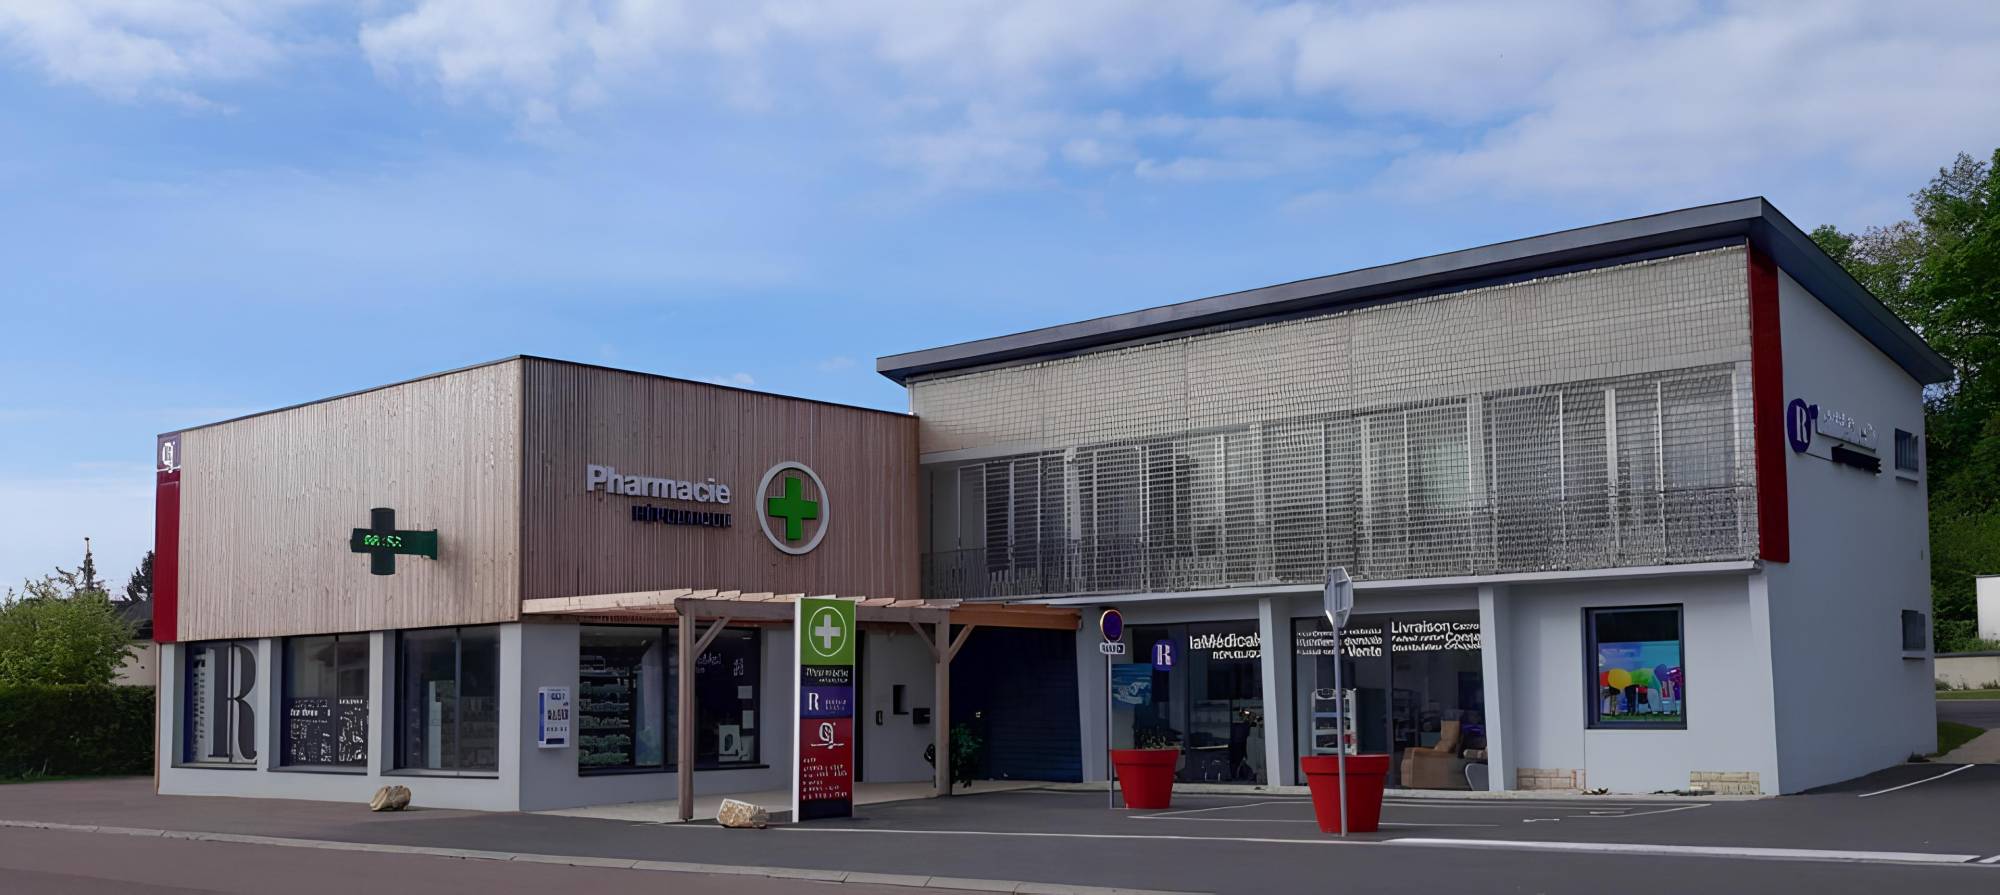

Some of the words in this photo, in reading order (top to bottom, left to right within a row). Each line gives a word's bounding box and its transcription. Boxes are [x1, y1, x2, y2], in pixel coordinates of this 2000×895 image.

[586, 464, 731, 504] Pharmacie
[1156, 644, 1172, 666] R
[206, 645, 257, 760] R
[808, 692, 819, 711] R
